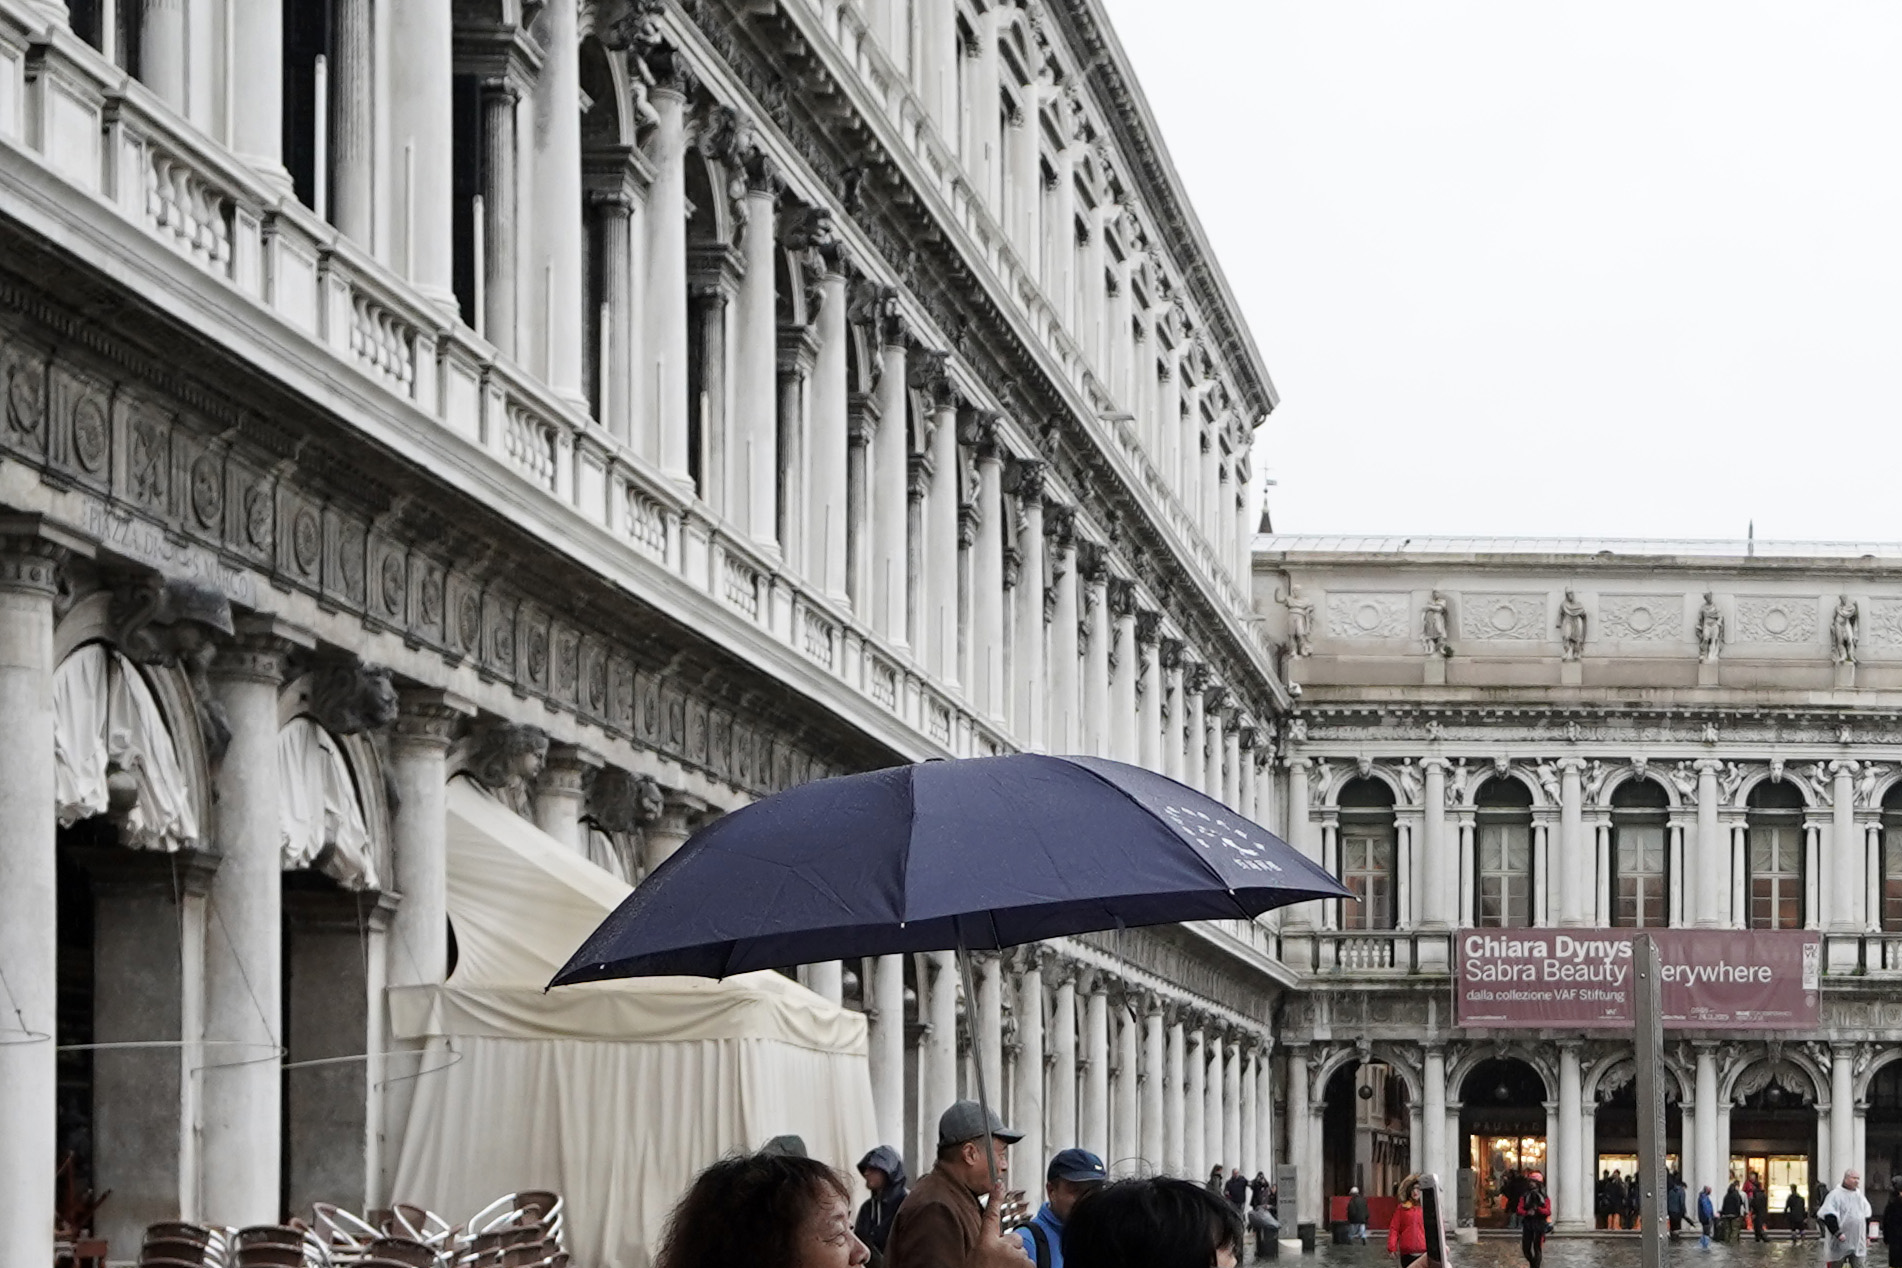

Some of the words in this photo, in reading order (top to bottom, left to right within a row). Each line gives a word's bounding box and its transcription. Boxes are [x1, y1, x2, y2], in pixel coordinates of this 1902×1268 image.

[89, 504, 139, 551] PIAZZA
[1465, 935, 1547, 958] Chiara
[1555, 936, 1632, 963] Dynys
[1466, 959, 1536, 982] Sabra
[1544, 959, 1627, 986] Beauty
[1466, 989, 1493, 1001] dalla
[1496, 989, 1551, 1001] collezione
[1554, 989, 1577, 1001] VAF
[1579, 989, 1625, 1003] Stiftung
